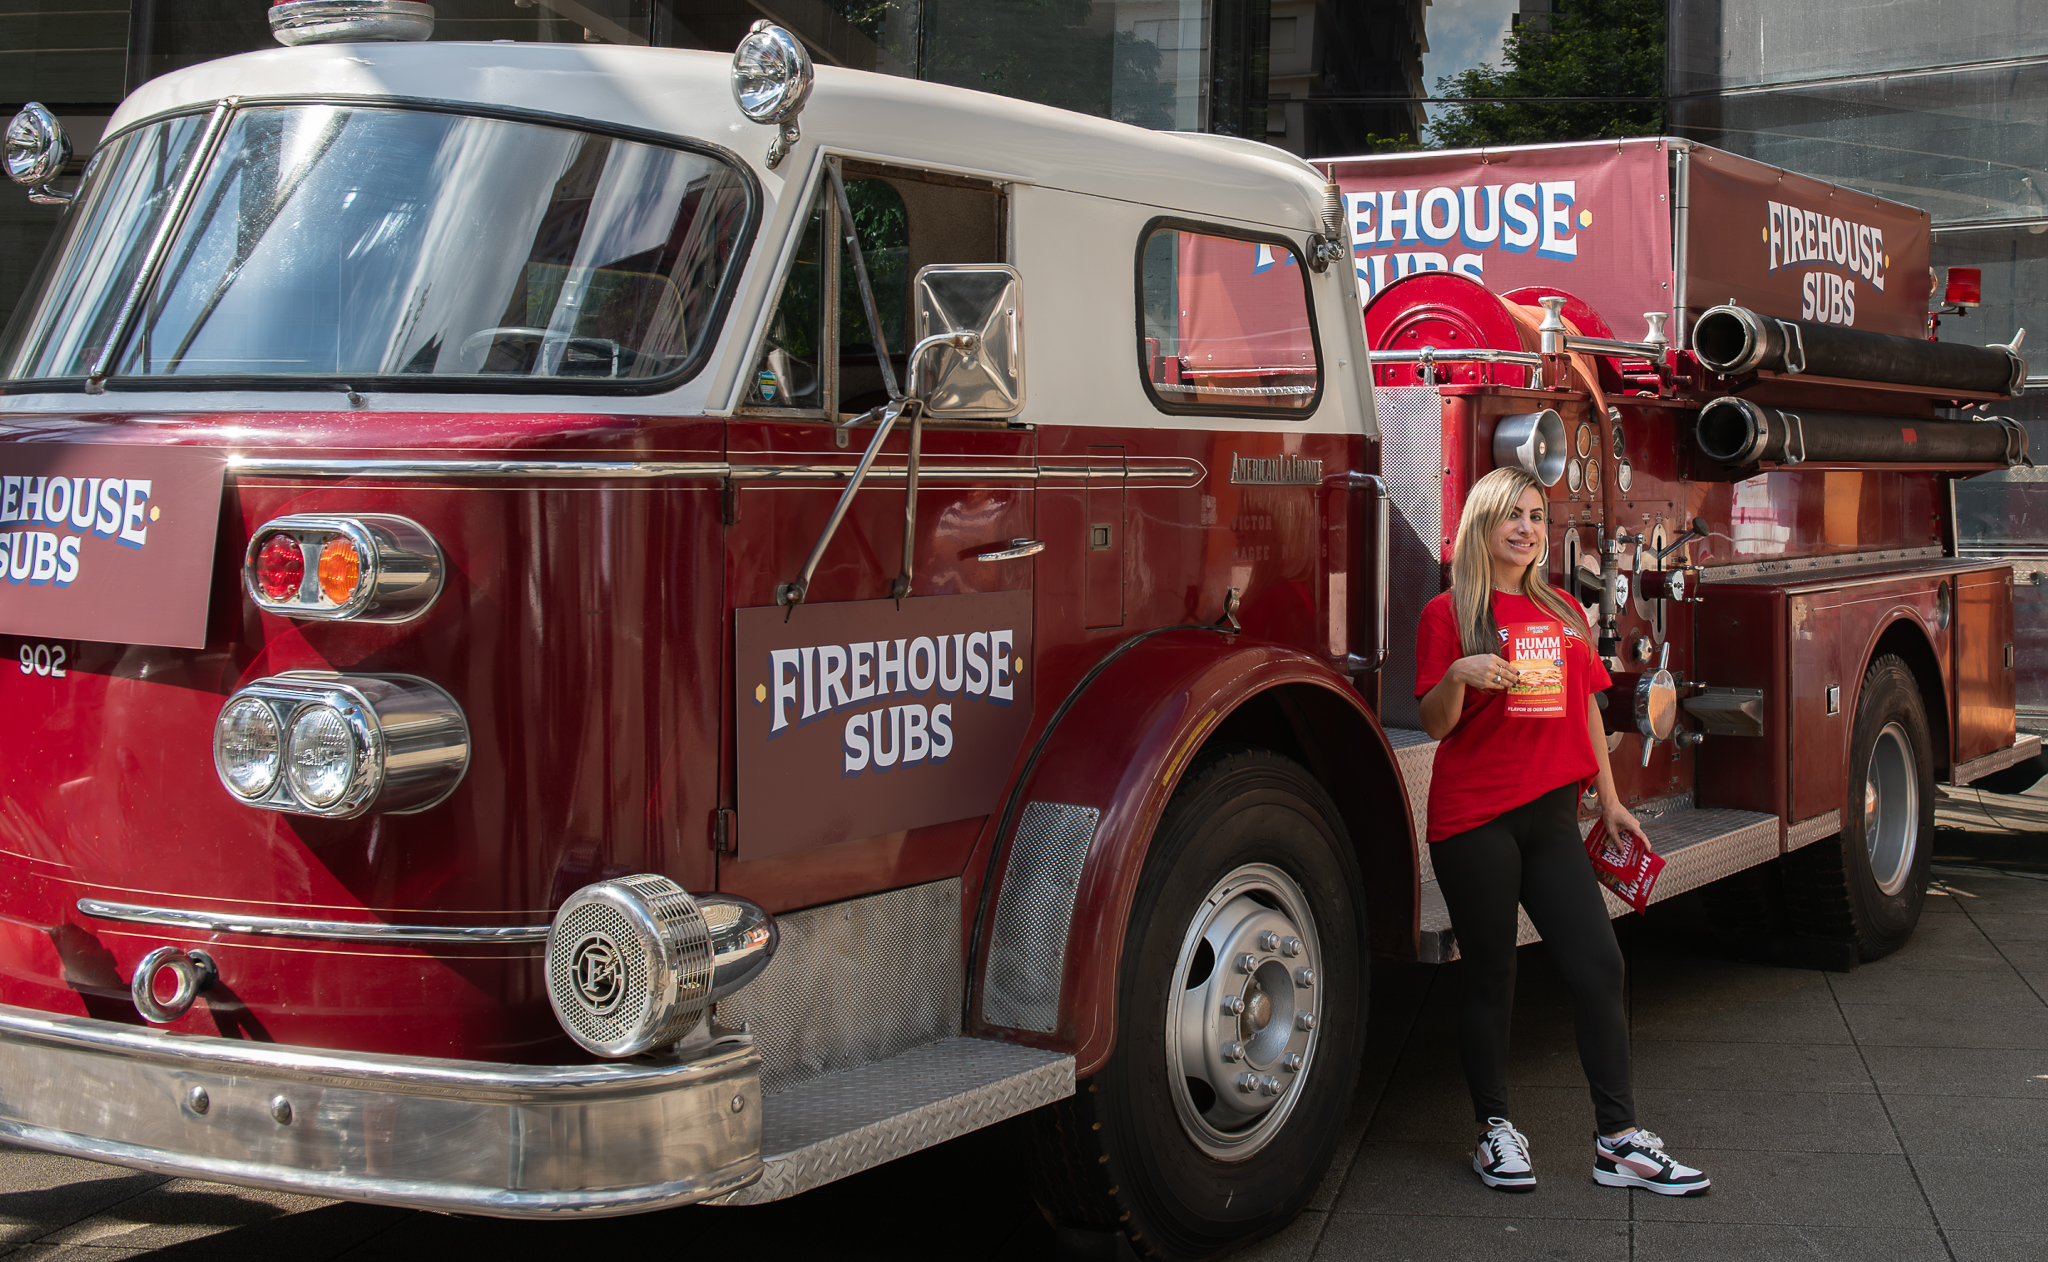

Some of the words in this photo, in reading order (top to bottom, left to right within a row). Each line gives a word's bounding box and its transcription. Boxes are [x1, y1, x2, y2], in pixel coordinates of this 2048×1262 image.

[1768, 200, 1885, 293] FIREHOUSE
[1802, 271, 1855, 327] SUBS
[1230, 451, 1279, 482] AMERICAN
[0, 475, 153, 548] EHOUSE
[1230, 514, 1272, 531] VICTOR
[1230, 544, 1270, 563] MAGEE
[19, 643, 67, 678] 902
[1515, 636, 1560, 650] HUMM
[1515, 648, 1561, 661] MMM!
[769, 629, 1014, 739] FIREHOUSE
[843, 703, 954, 777] SUBS
